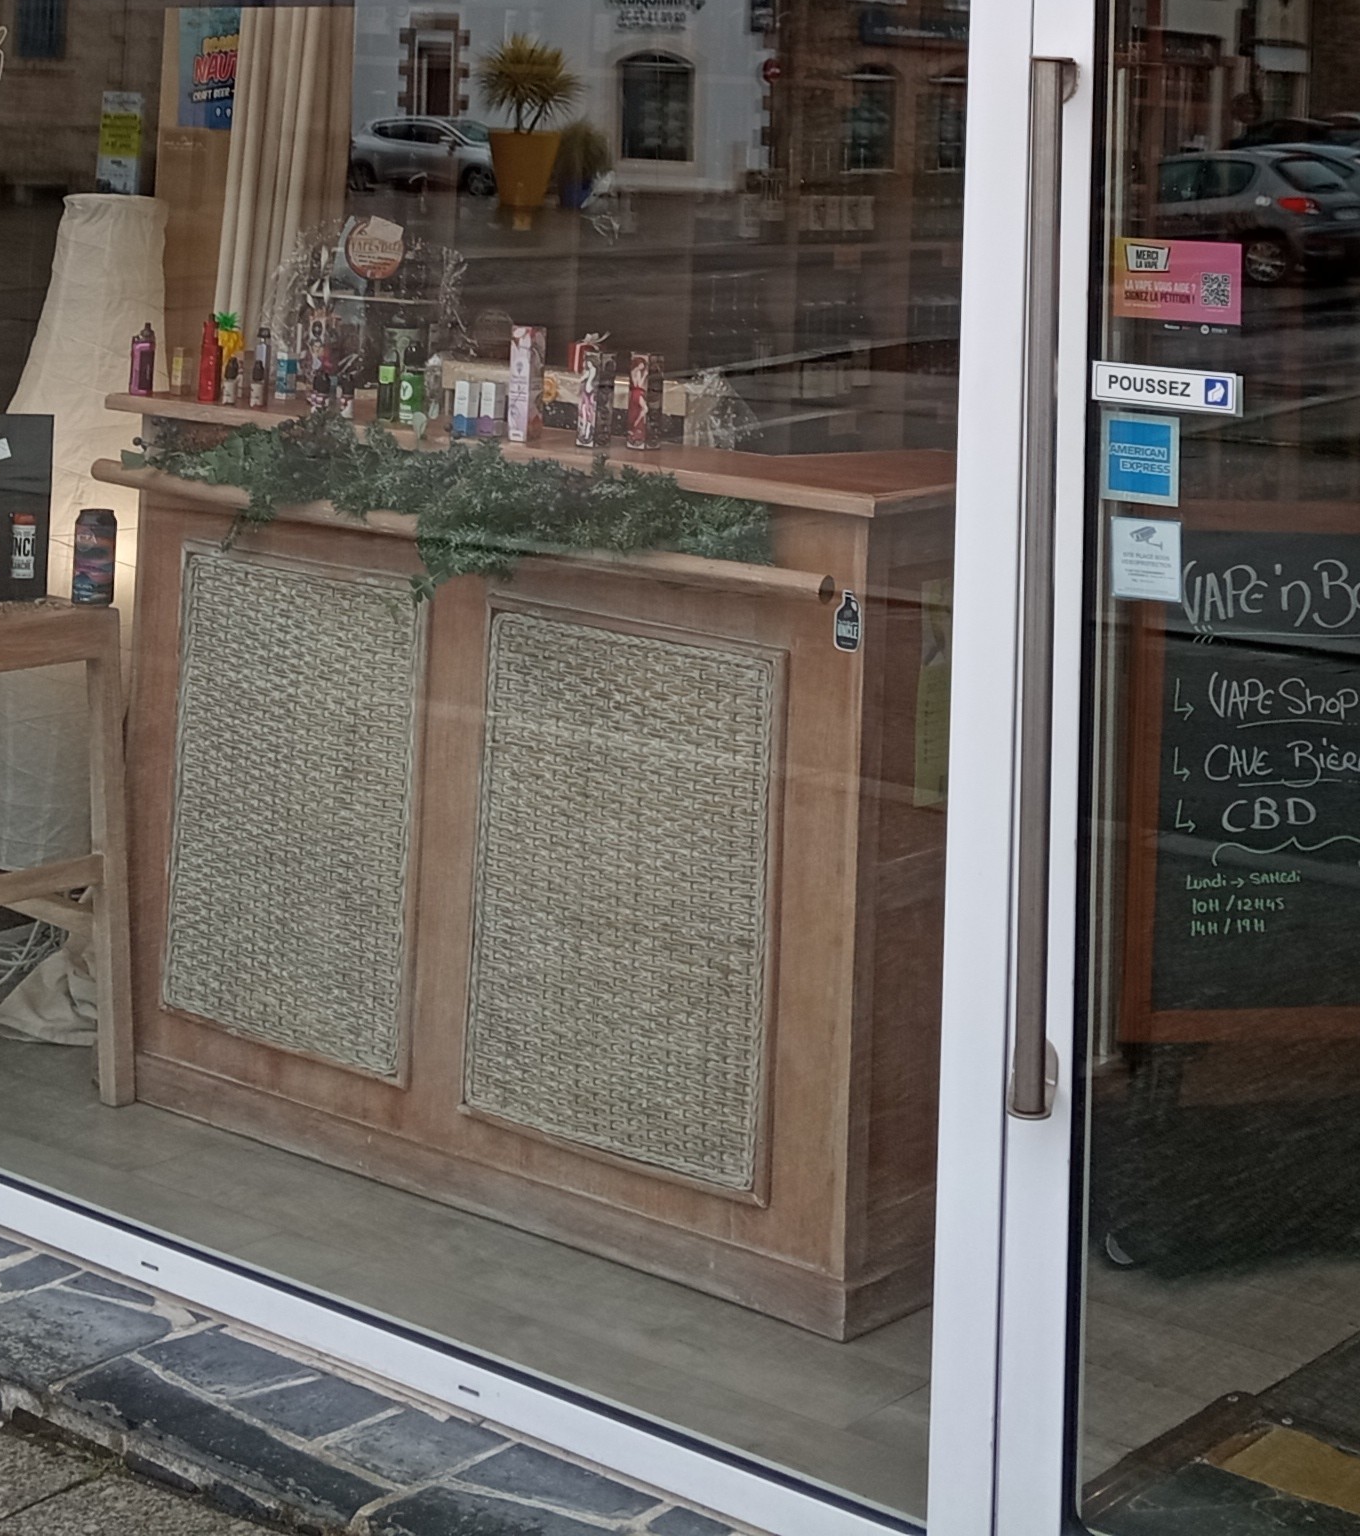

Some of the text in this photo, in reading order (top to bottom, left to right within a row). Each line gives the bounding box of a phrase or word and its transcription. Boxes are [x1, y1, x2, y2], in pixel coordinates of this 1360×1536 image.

[1136, 250, 1158, 260] MERCI
[1144, 261, 1158, 269] VAPE
[1125, 279, 1133, 290] LA
[1134, 280, 1153, 291] VAPE
[1154, 281, 1173, 292] VOUS
[1125, 290, 1148, 302] SIGNEZ
[1150, 292, 1159, 302] LA
[1108, 374, 1191, 398] POUSSEZ
[1110, 443, 1166, 460] AMERICAN
[1121, 460, 1171, 475] EXPRESS
[1182, 561, 1269, 624] VAPE
[1209, 672, 1274, 720] VAPE
[1204, 744, 1273, 781] CAVE
[1221, 797, 1317, 832] CBD
[1186, 873, 1226, 890] Lundi
[1192, 898, 1219, 914] 10H
[1237, 897, 1285, 911] 12H45
[1191, 920, 1218, 936] 14H
[1237, 918, 1265, 933] 19H
